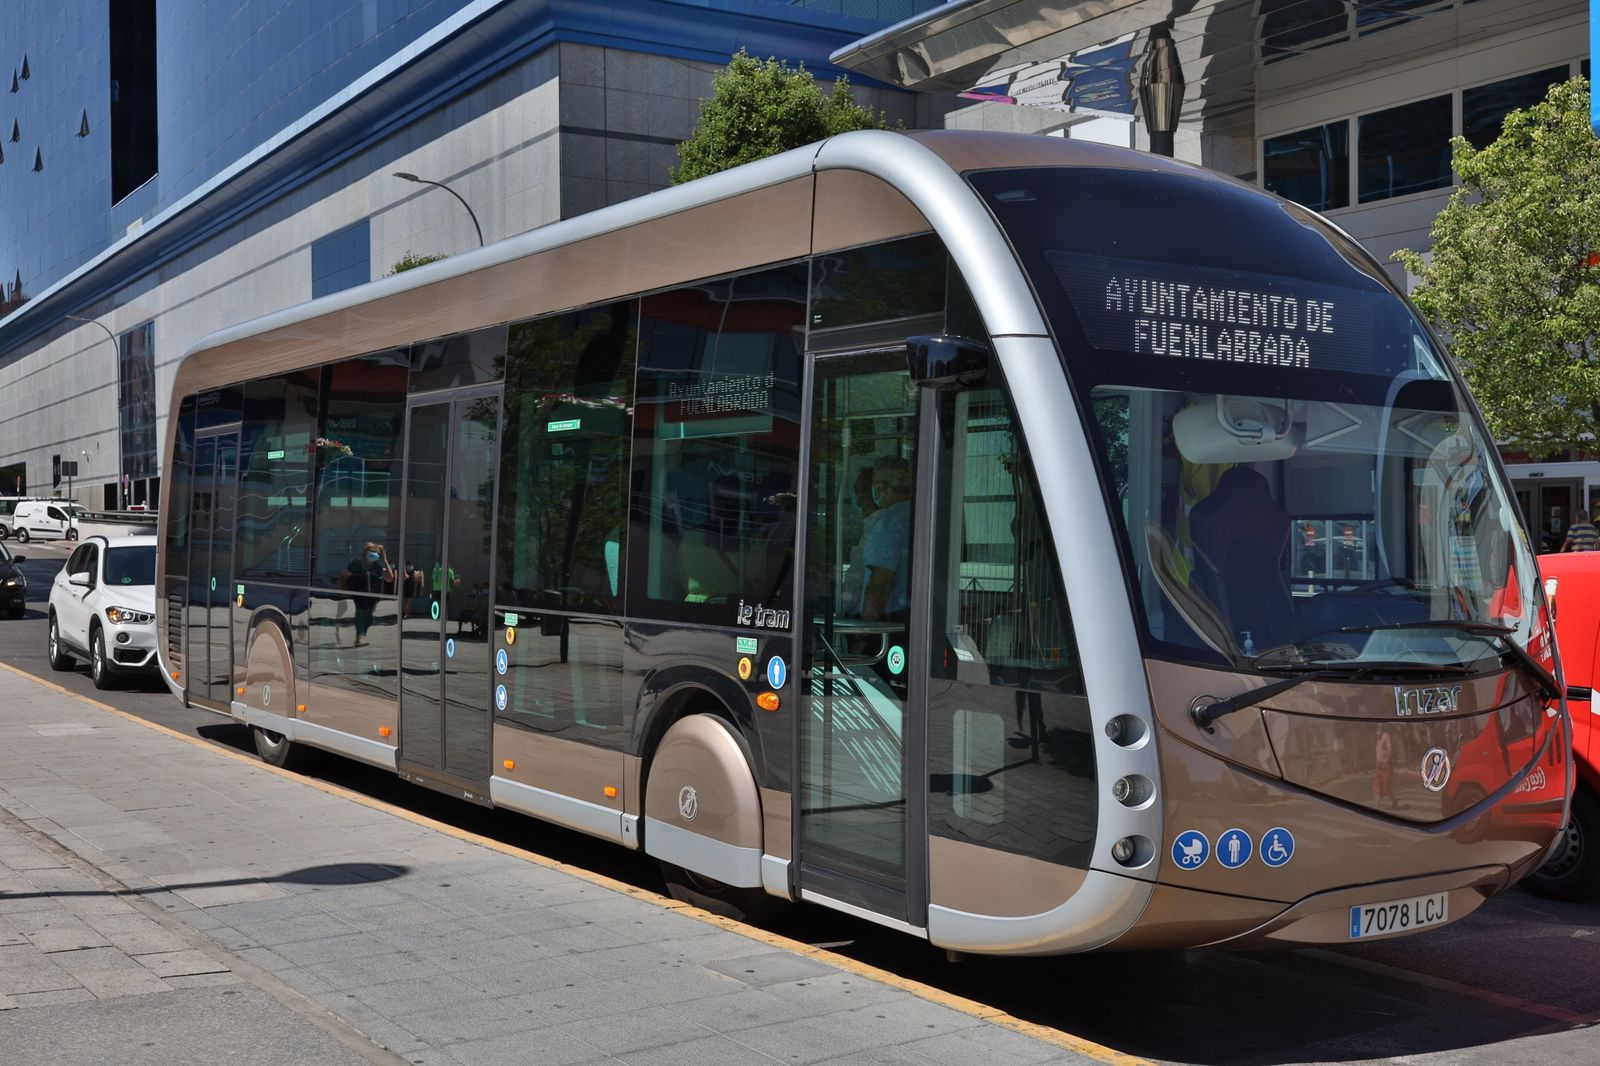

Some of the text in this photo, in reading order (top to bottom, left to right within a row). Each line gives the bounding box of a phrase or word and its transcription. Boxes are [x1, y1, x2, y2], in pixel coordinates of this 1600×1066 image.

[1105, 277, 1335, 333] AYUNTAMIENTO DE
[1134, 319, 1310, 367] FUENLABRADA
[736, 599, 790, 629] ie tram
[1364, 896, 1445, 933] 7078 LCJ
